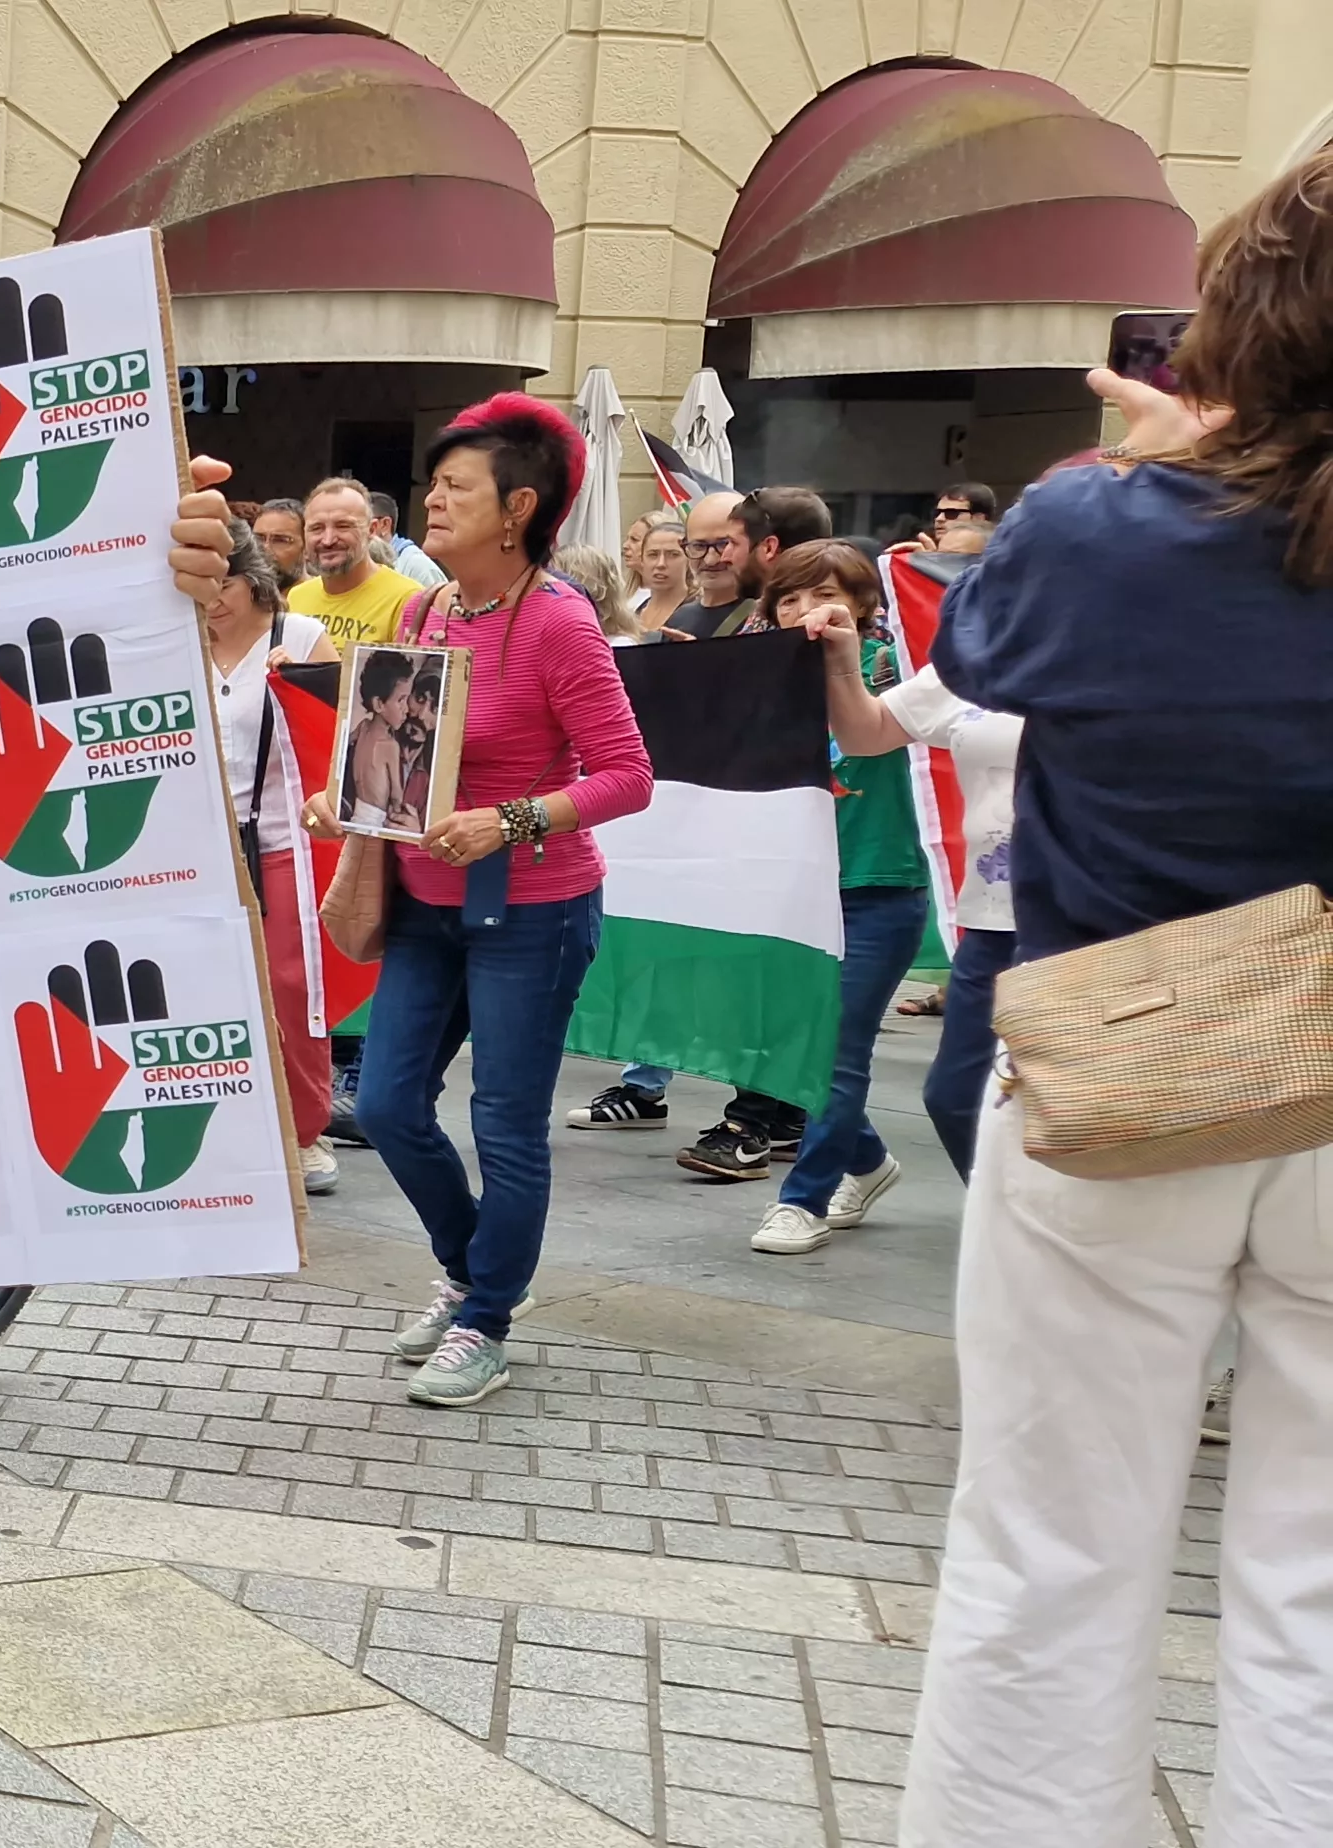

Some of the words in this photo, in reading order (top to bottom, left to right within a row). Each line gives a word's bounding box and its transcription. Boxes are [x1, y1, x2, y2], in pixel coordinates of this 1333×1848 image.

[33, 353, 146, 406] STOP
[39, 391, 147, 425] GENOCIDIO
[40, 411, 150, 445] PALESTINO
[78, 694, 190, 742] STOP
[85, 731, 193, 760] GENOCIDIO
[87, 750, 196, 780] PALESTINO
[8, 868, 197, 903] #STOPGENOCIDIOPALESTINO
[135, 1023, 247, 1065] STOP
[143, 1060, 250, 1083] GENOCIDIO
[144, 1079, 253, 1102] PALESTINO
[66, 1194, 254, 1217] #STOPGENOCIDIOPALESTINO
